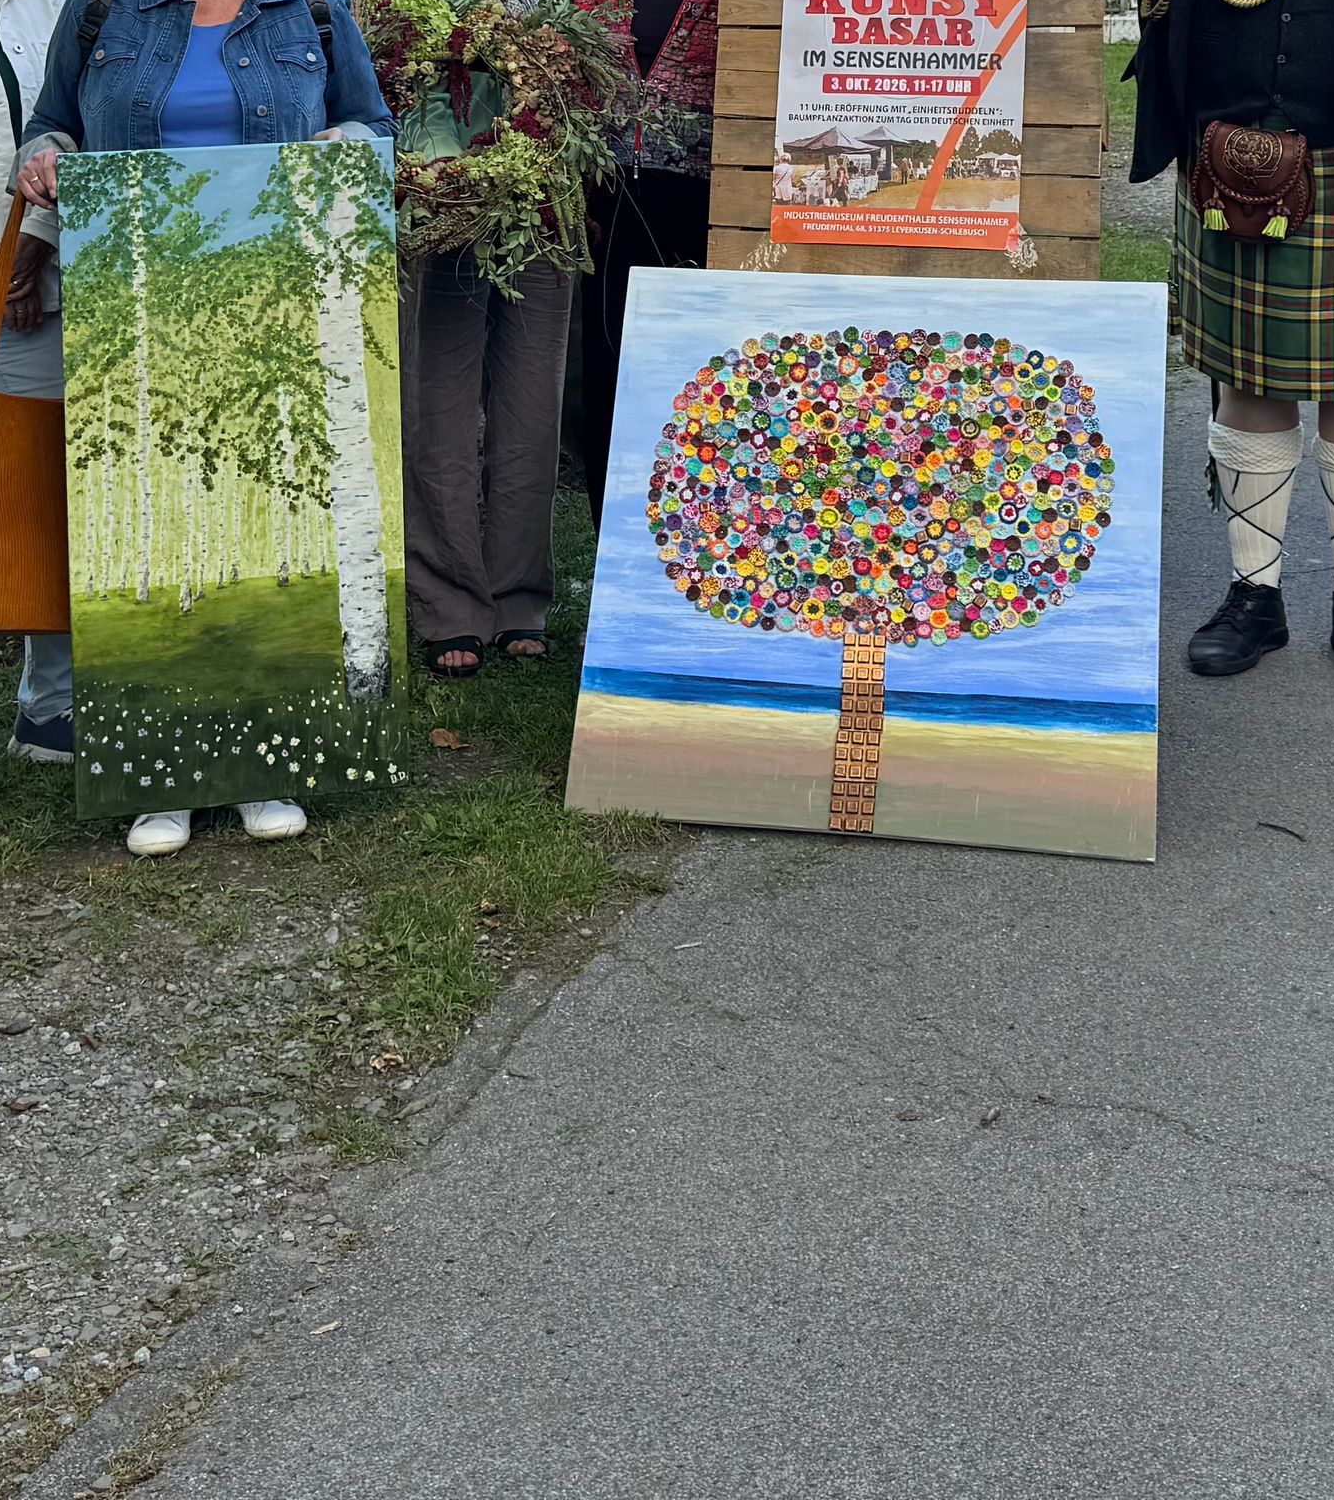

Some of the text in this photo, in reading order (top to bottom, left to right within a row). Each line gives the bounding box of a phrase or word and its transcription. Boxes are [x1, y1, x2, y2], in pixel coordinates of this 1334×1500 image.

[831, 17, 975, 46] BASAR
[803, 50, 1002, 70] IM SENSENHAMMER
[831, 78, 971, 93] 3. OKT. 2026, 11-17 UHR
[812, 104, 833, 112] UHR:
[835, 104, 889, 113] ERÖFFNUNG
[891, 105, 907, 113] MIT
[789, 114, 874, 123] BAUMPFLANZAKTION
[896, 116, 911, 124] TAG
[931, 117, 980, 125] DEUTSCHEN
[982, 118, 1014, 126] EINHEIT
[783, 212, 1009, 226] INDUSTRIEMUSEUM FREUDENTHALER SENSENHAMMER
[803, 223, 854, 232] FREUDENTHAL
[891, 226, 988, 236] LEVERKUSEN-SCHLEBUSCH
